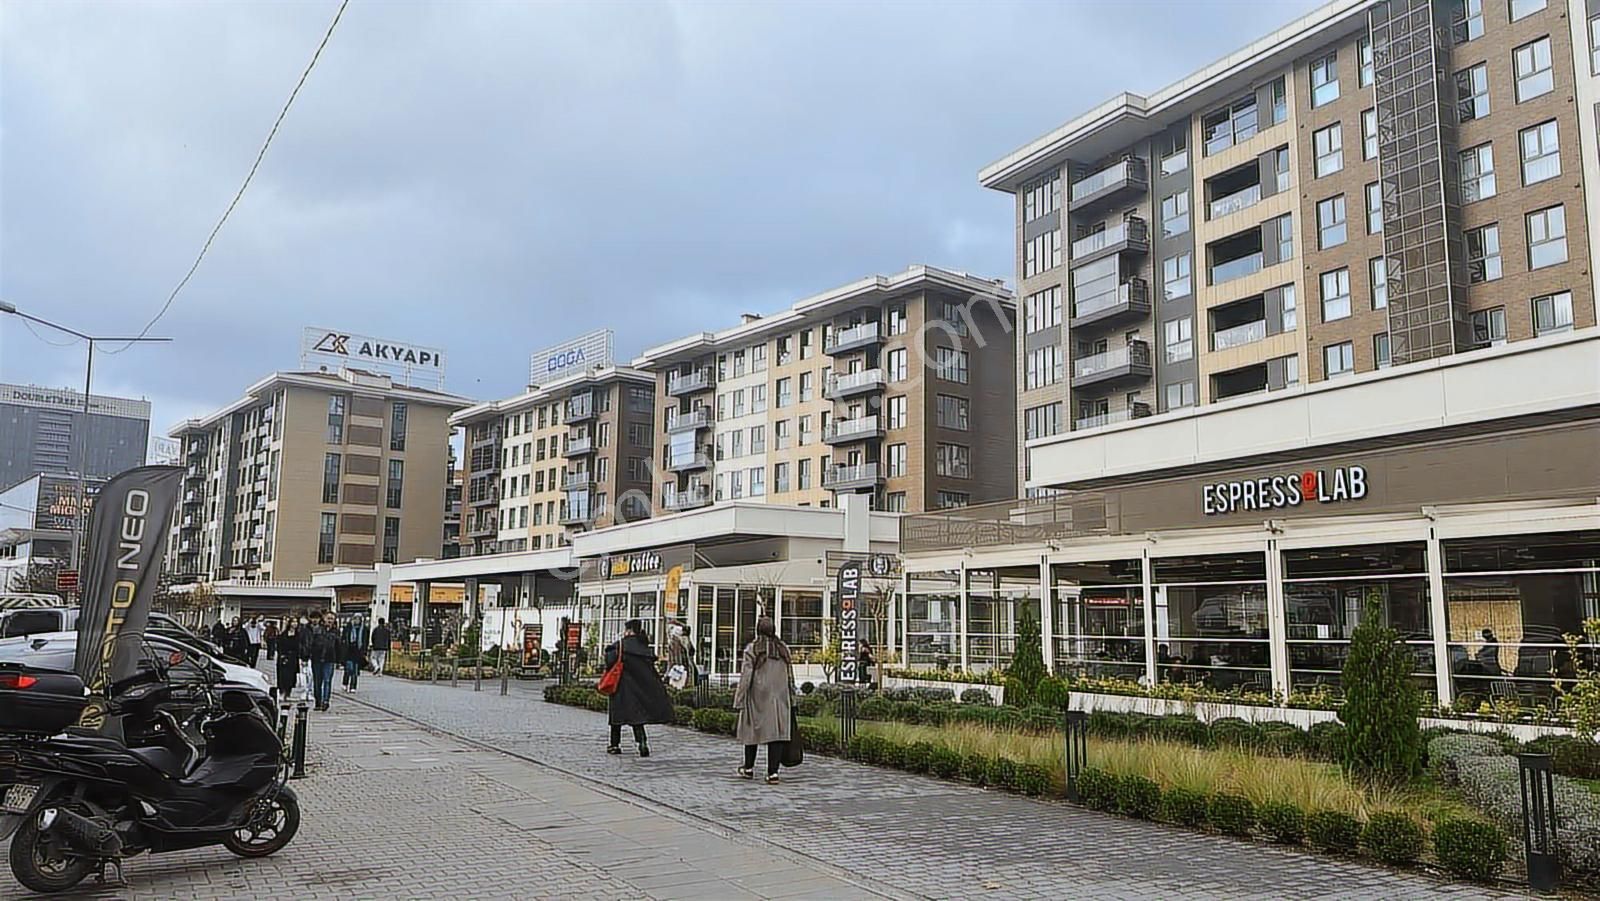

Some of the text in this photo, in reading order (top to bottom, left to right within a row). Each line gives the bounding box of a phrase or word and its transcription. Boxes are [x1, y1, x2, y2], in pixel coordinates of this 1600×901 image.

[358, 342, 440, 367] AKYAPI
[117, 489, 149, 570] NEO
[630, 551, 661, 573] coffee
